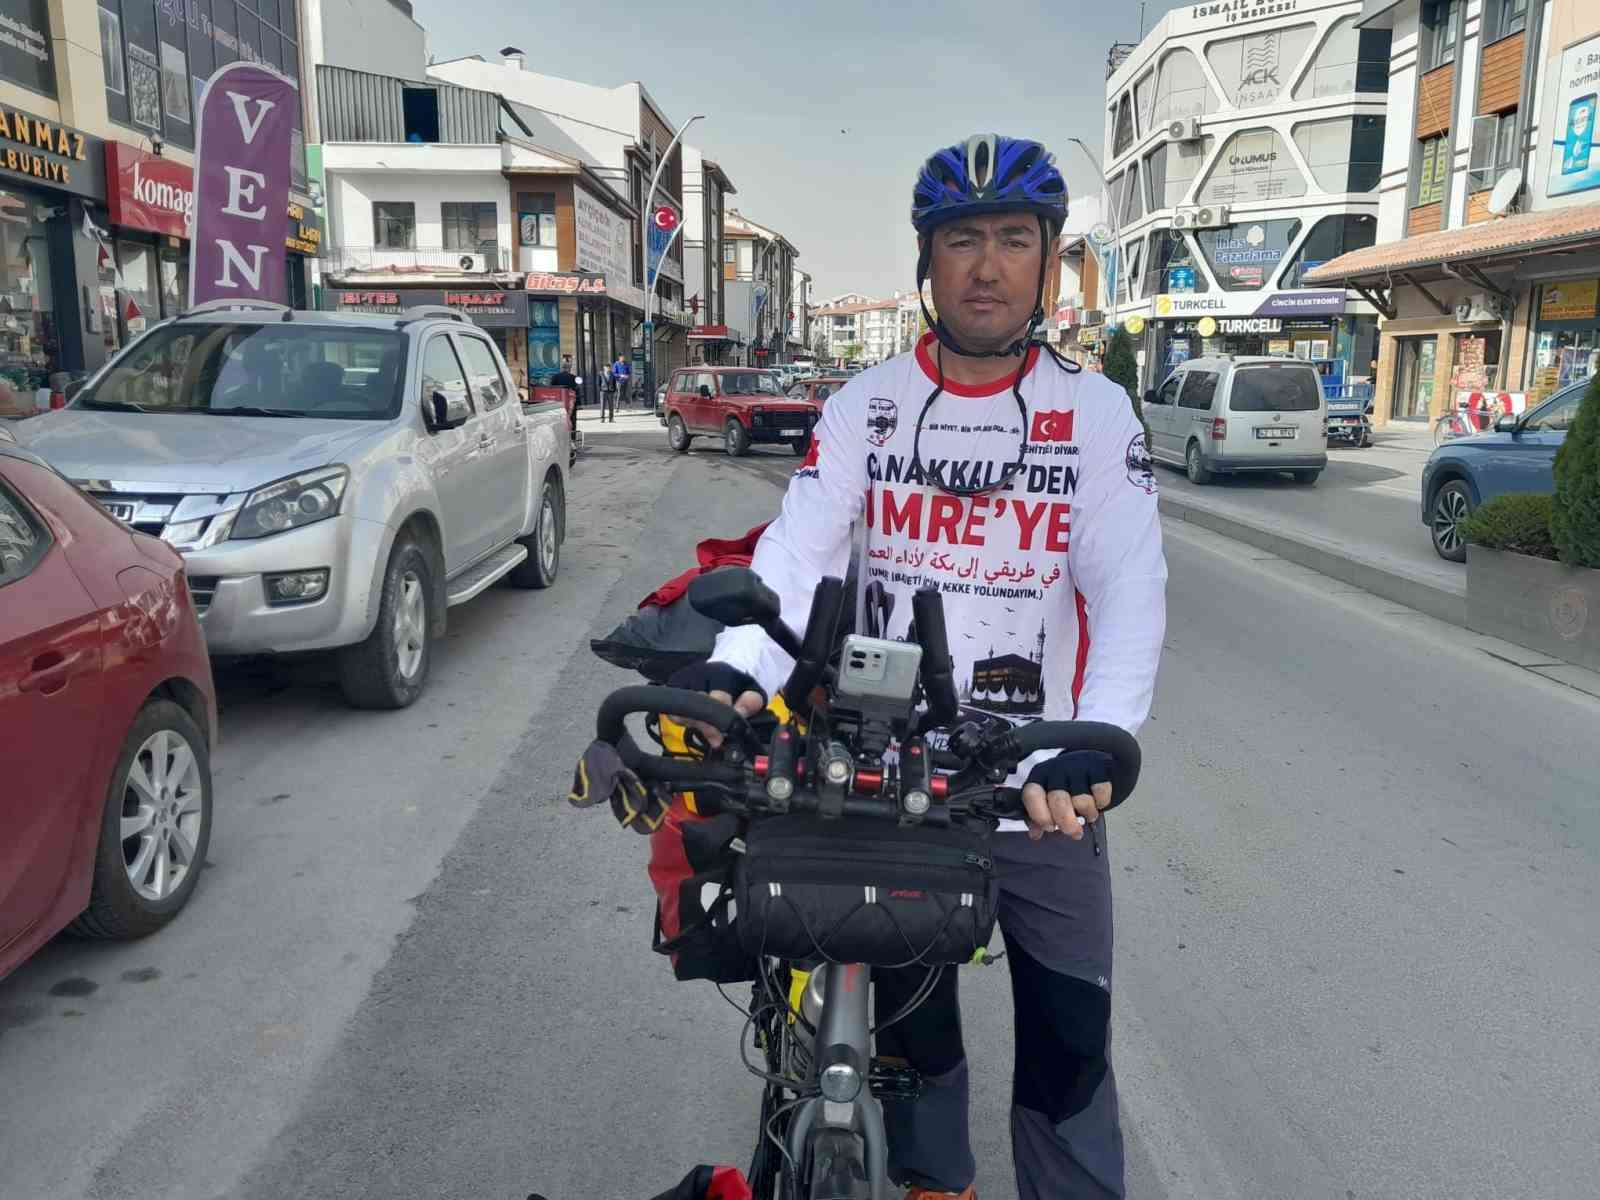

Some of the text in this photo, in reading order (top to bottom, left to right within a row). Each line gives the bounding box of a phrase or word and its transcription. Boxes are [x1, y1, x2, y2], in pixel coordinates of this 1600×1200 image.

[214, 91, 275, 311] VEN
[1173, 299, 1226, 310] TURKCELL
[1219, 318, 1282, 333] TURKCELL
[958, 557, 980, 580] إلى
[984, 560, 1036, 586] طريقي
[1041, 563, 1061, 589] في
